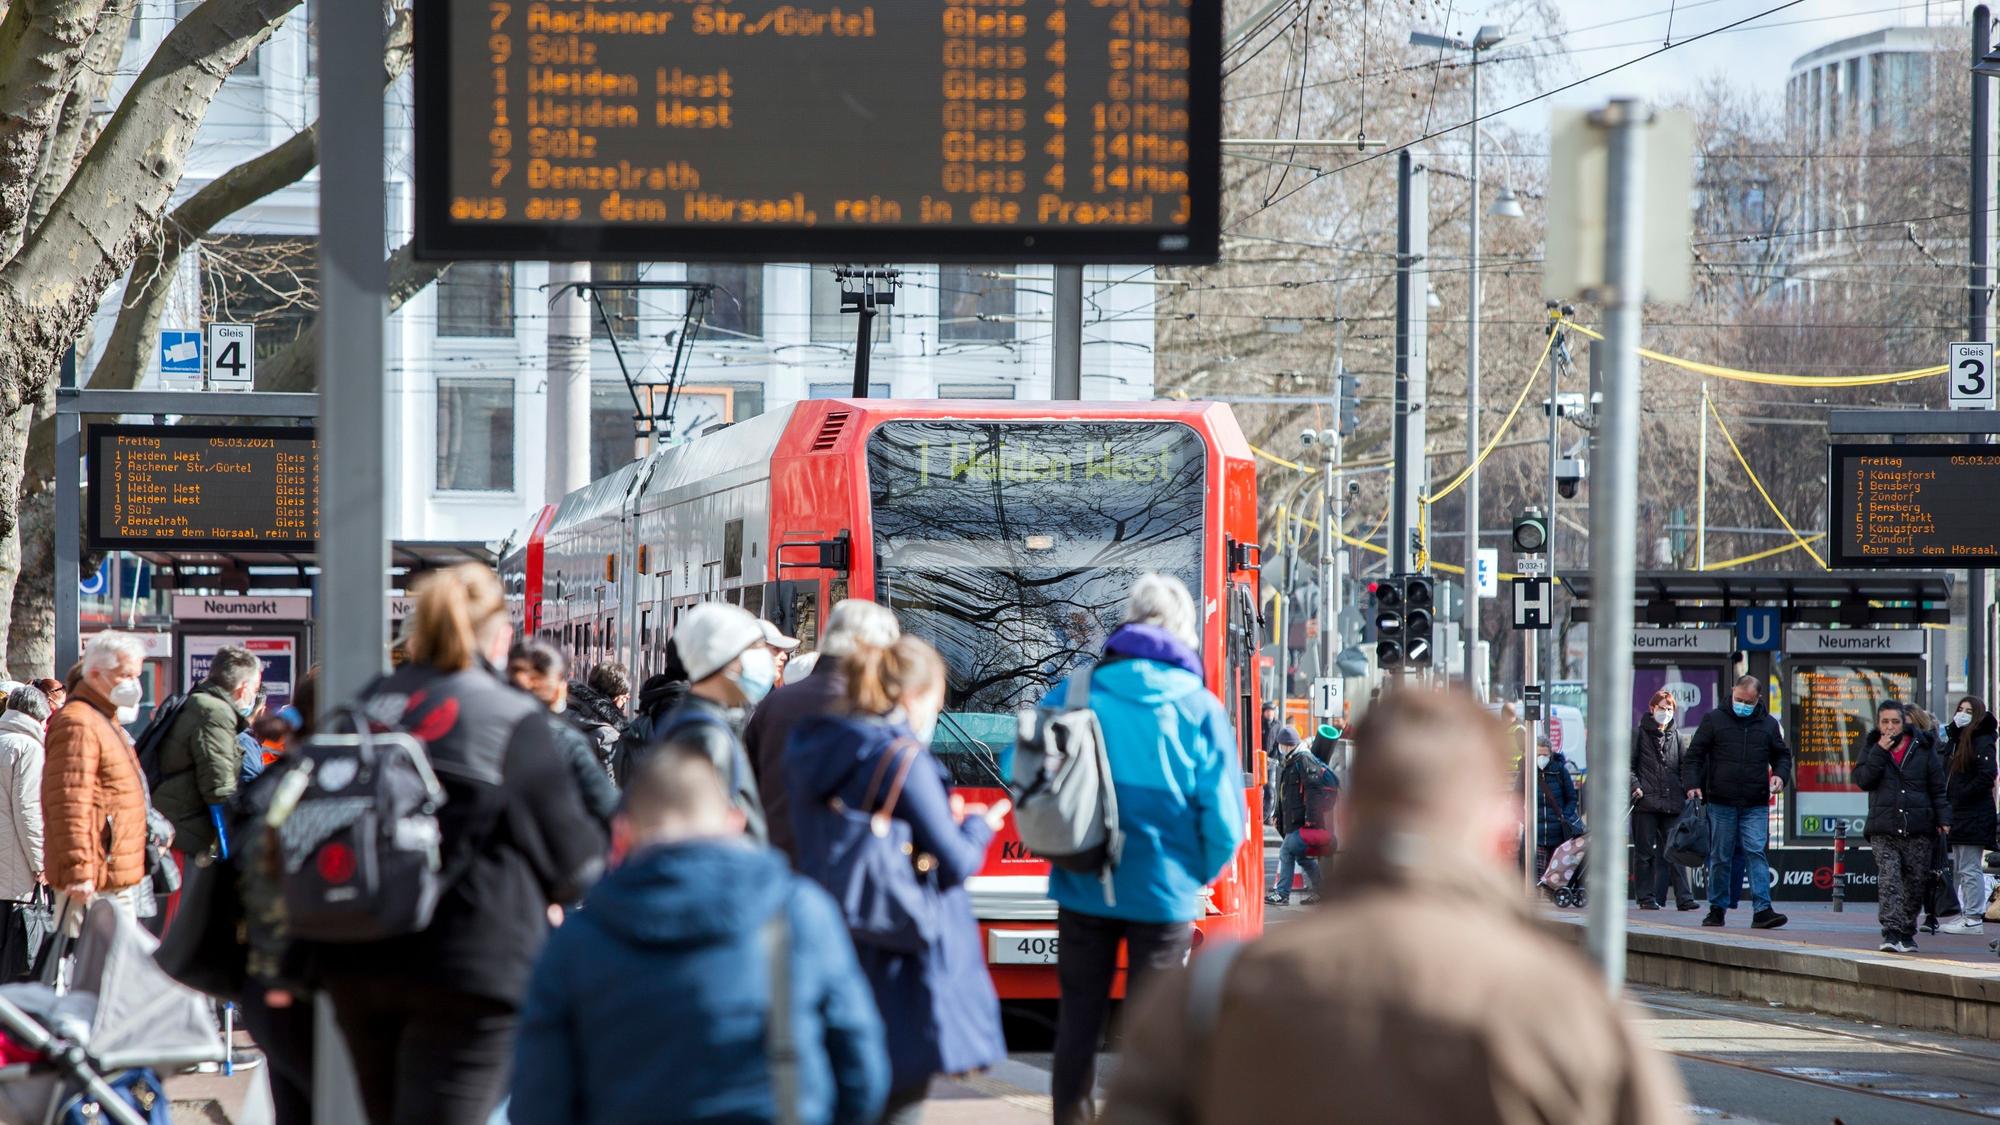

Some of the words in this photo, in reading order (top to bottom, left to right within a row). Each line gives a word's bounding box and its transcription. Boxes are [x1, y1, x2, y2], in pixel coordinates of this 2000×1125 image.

[490, 2, 511, 33] 7
[527, 2, 672, 34] Aachener
[943, 7, 1027, 37] Gleis
[1046, 9, 1066, 35] 4
[489, 34, 511, 64] 9
[943, 38, 1027, 69] Gleis
[1046, 39, 1066, 67] 4
[491, 66, 509, 95] 1
[527, 66, 638, 97] Weiden
[655, 66, 733, 98] West
[943, 70, 1027, 100] Gleis
[1046, 71, 1066, 99] 4
[491, 98, 509, 127] 1
[527, 98, 638, 128] Weiden
[655, 98, 733, 128] West
[943, 101, 1026, 131] Gleis
[1045, 103, 1066, 131] 4
[489, 127, 512, 158] 9
[943, 132, 1026, 162] Gleis
[1045, 133, 1065, 160] 4
[490, 158, 512, 189] 7
[527, 158, 700, 190] Benzelrath
[942, 163, 1026, 193] Gleis
[1044, 164, 1065, 192] 4
[450, 197, 506, 221] aus
[525, 197, 581, 221] aus
[601, 191, 666, 221] dem
[835, 195, 901, 223] rein
[921, 195, 952, 223] in
[970, 195, 1020, 224] die
[219, 328, 244, 338] Gleis
[1960, 347, 1984, 357] Gleis
[216, 341, 246, 376] 4
[1957, 359, 1986, 395] 3
[118, 436, 161, 448] Freitag
[210, 438, 275, 448] 05.03.2021
[116, 451, 121, 460] 1
[128, 451, 167, 461] Weiden
[173, 452, 201, 461] West
[276, 453, 305, 463] Gleis
[950, 440, 1072, 482] Weiden
[1085, 440, 1173, 482] West
[1860, 456, 1903, 468] Freitag
[115, 461, 122, 471] 7
[128, 462, 179, 472] Aachener
[276, 463, 305, 473] Gleis
[115, 472, 122, 482] 9
[276, 474, 305, 484] Gleis
[1857, 470, 1864, 480] 9
[1870, 470, 1936, 481] Königsforst
[116, 483, 121, 493] 1
[128, 483, 167, 493] Weiden
[173, 484, 201, 494] West
[276, 485, 305, 495] Gleis
[1858, 481, 1863, 491] 1
[1870, 481, 1921, 493] Bensberg
[116, 494, 121, 504] 1
[128, 494, 167, 504] Weiden
[173, 494, 201, 504] West
[276, 496, 305, 506] Gleis
[1857, 491, 1864, 501] 7
[1870, 491, 1914, 503] Zündorf
[115, 504, 122, 514] 9
[276, 507, 305, 517] Gleis
[1858, 502, 1863, 512] 1
[1870, 502, 1921, 514] Bensberg
[115, 515, 121, 525] 7
[128, 516, 188, 526] Benzelrath
[276, 517, 305, 527] Gleis
[1856, 512, 1864, 522] E
[1869, 513, 1895, 522] Porz
[1901, 512, 1932, 523] Markt
[121, 526, 148, 536] Raus
[155, 528, 175, 536] aus
[182, 527, 205, 537] dem
[265, 529, 289, 538] rein
[296, 529, 307, 538] in
[1856, 523, 1864, 533] 9
[1856, 534, 1864, 544] 7
[1863, 544, 1889, 554] Raus
[1897, 546, 1915, 554] aus
[1922, 545, 1945, 555] dem
[205, 600, 277, 614] Neumarkt
[1515, 582, 1549, 625] H
[1746, 614, 1770, 645] U
[1819, 635, 1891, 649] Neumarkt
[1783, 871, 1815, 885] KVB
